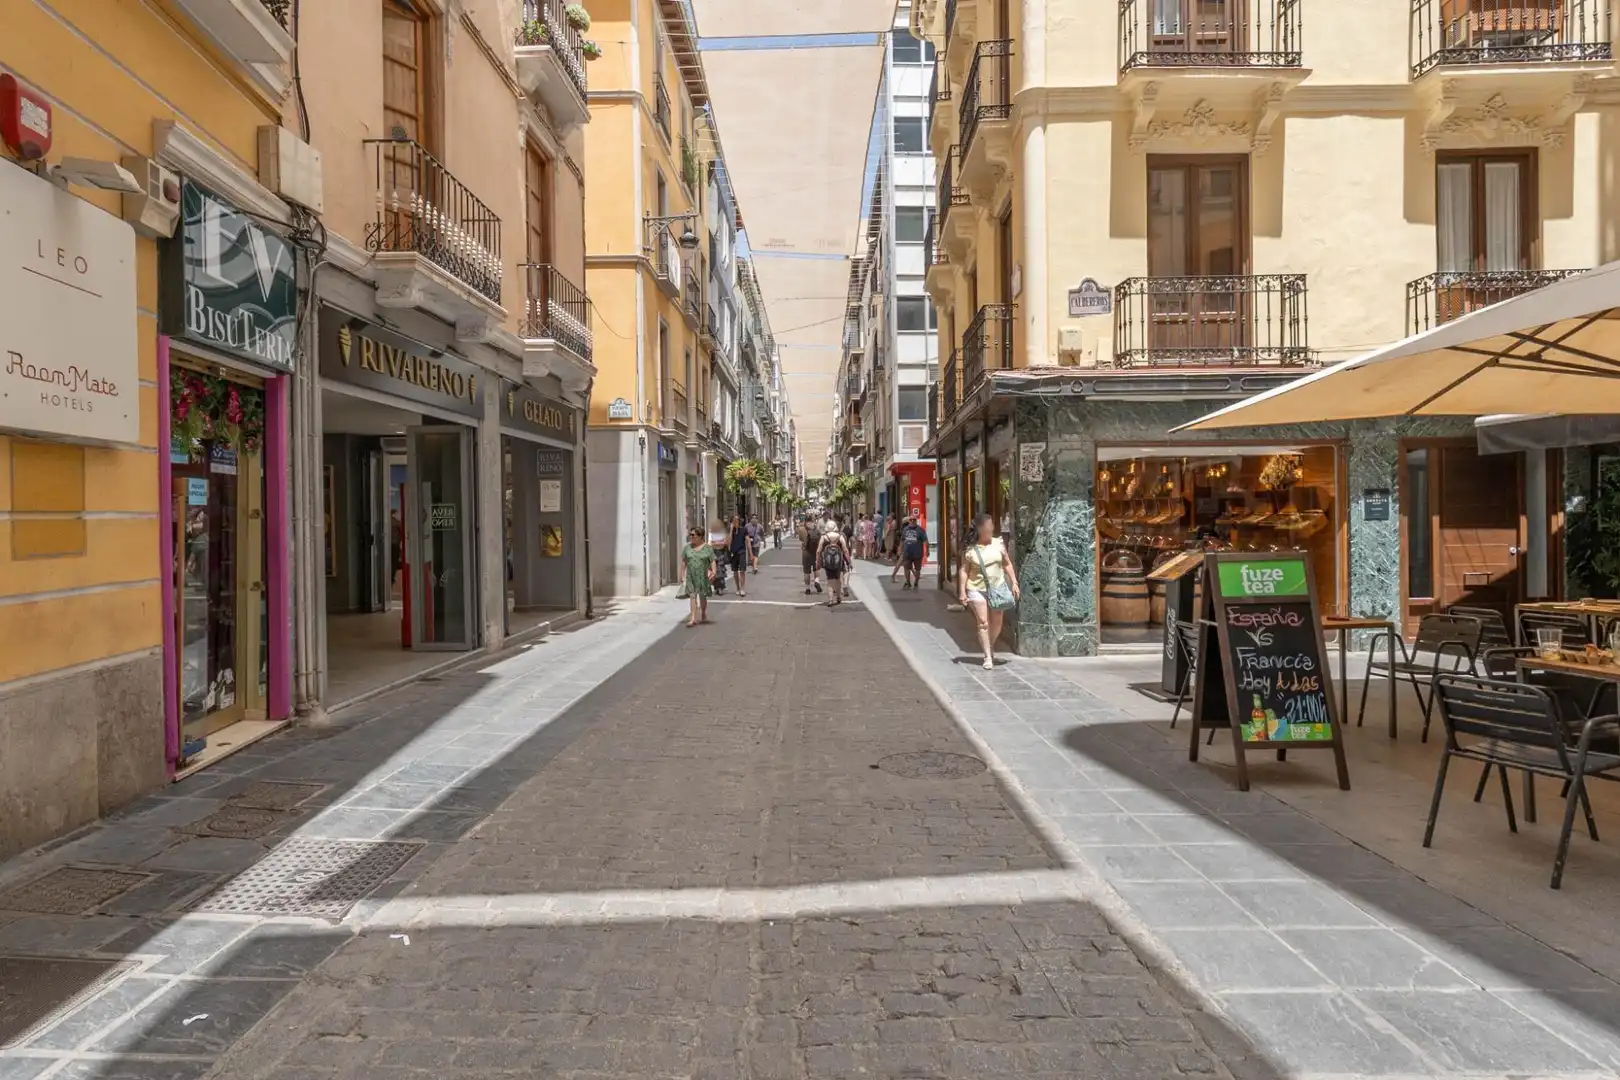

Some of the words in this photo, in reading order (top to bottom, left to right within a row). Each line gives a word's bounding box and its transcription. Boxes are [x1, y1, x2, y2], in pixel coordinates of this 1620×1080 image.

[37, 238, 88, 275] LEO
[357, 335, 464, 399] RIVARENO
[40, 392, 93, 412] HOTELS
[524, 399, 562, 430] GELATO
[1240, 564, 1284, 581] fuze
[1242, 579, 1275, 594] tea
[1238, 670, 1271, 699] Hoy
